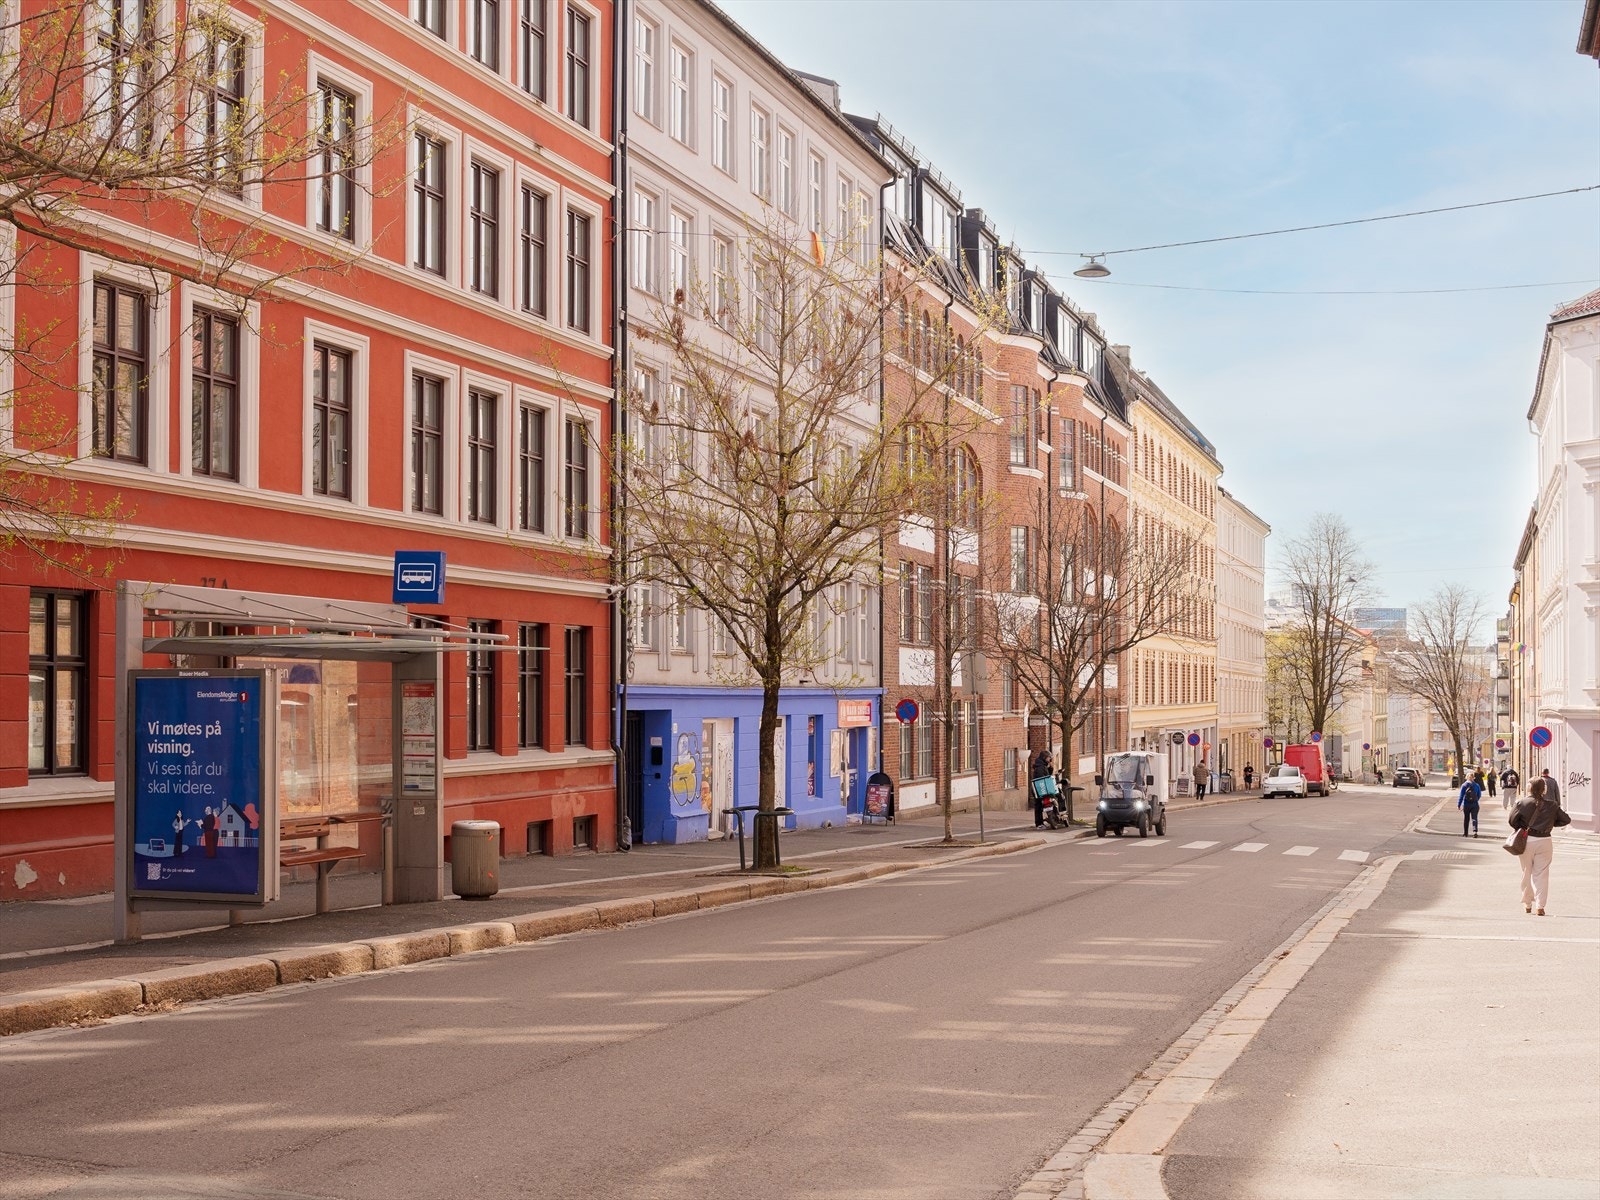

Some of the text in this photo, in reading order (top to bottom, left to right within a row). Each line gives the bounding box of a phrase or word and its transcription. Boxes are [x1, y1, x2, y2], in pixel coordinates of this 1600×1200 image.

[148, 720, 222, 738] Vi møtes på
[148, 739, 195, 757] visning.
[148, 760, 222, 776] Vi ses når du
[148, 779, 216, 795] skal videre.
